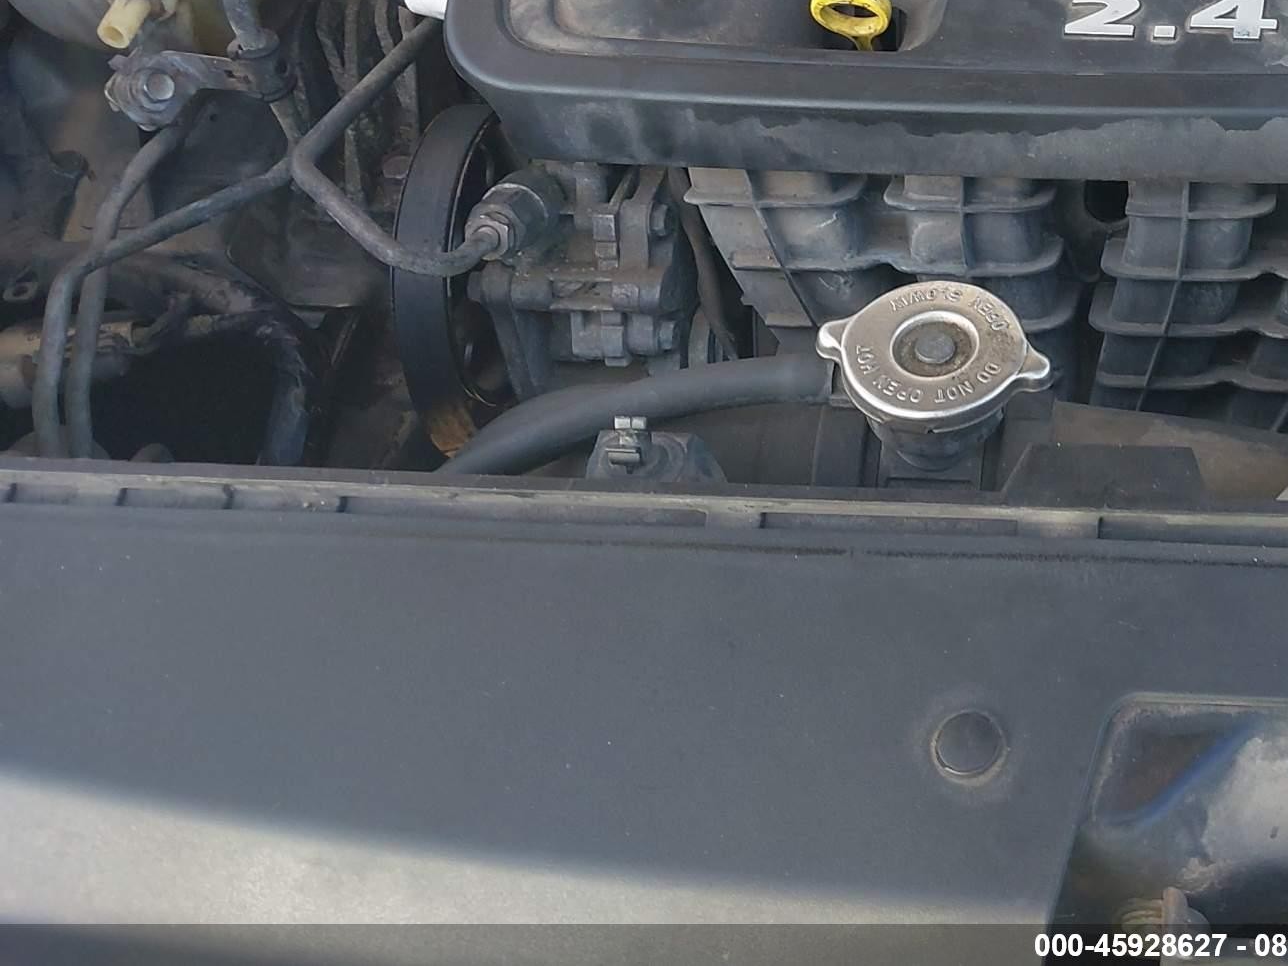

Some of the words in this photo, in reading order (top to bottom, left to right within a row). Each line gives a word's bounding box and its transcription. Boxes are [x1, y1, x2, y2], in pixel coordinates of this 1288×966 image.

[890, 286, 964, 312] SLOWLY
[968, 295, 1011, 331] OPEN
[855, 345, 878, 375] HOT
[976, 361, 1002, 386] DO
[872, 376, 924, 404] OPEN
[933, 381, 976, 403] NOT
